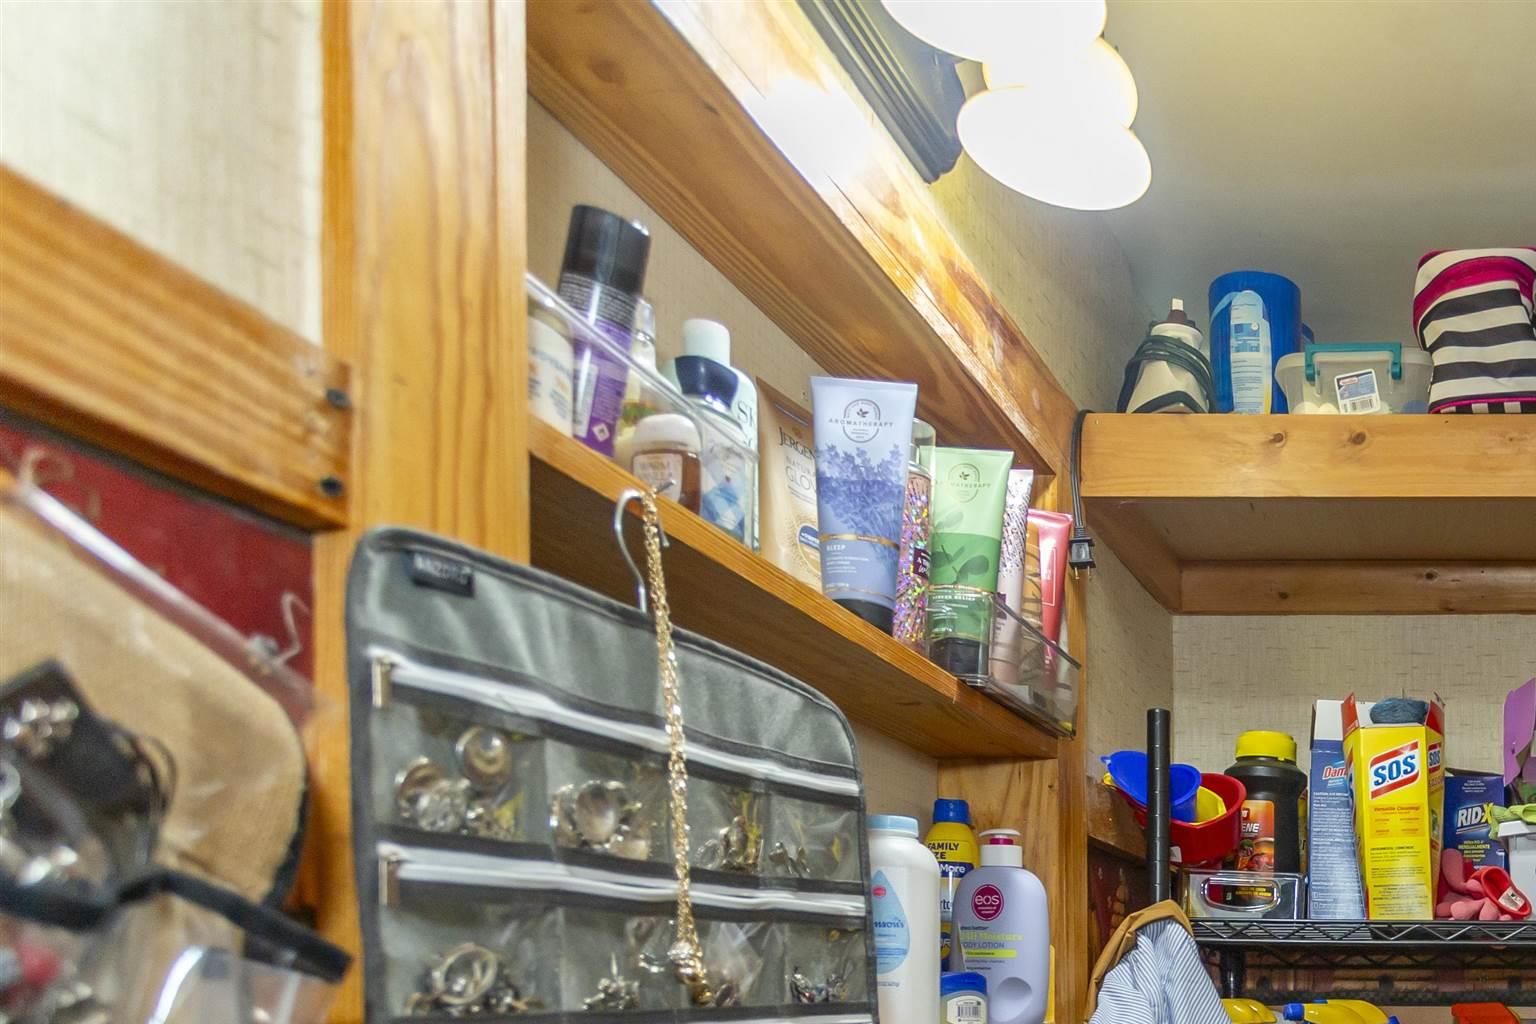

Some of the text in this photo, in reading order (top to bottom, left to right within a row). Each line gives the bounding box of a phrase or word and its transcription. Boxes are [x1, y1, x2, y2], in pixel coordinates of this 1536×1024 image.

[828, 418, 894, 427] AROMATHERAPY
[778, 426, 817, 460] JERGEN
[1322, 766, 1348, 780] Dam
[1457, 802, 1494, 827] RID-X
[1242, 823, 1260, 833] ENE
[975, 895, 1000, 905] eos
